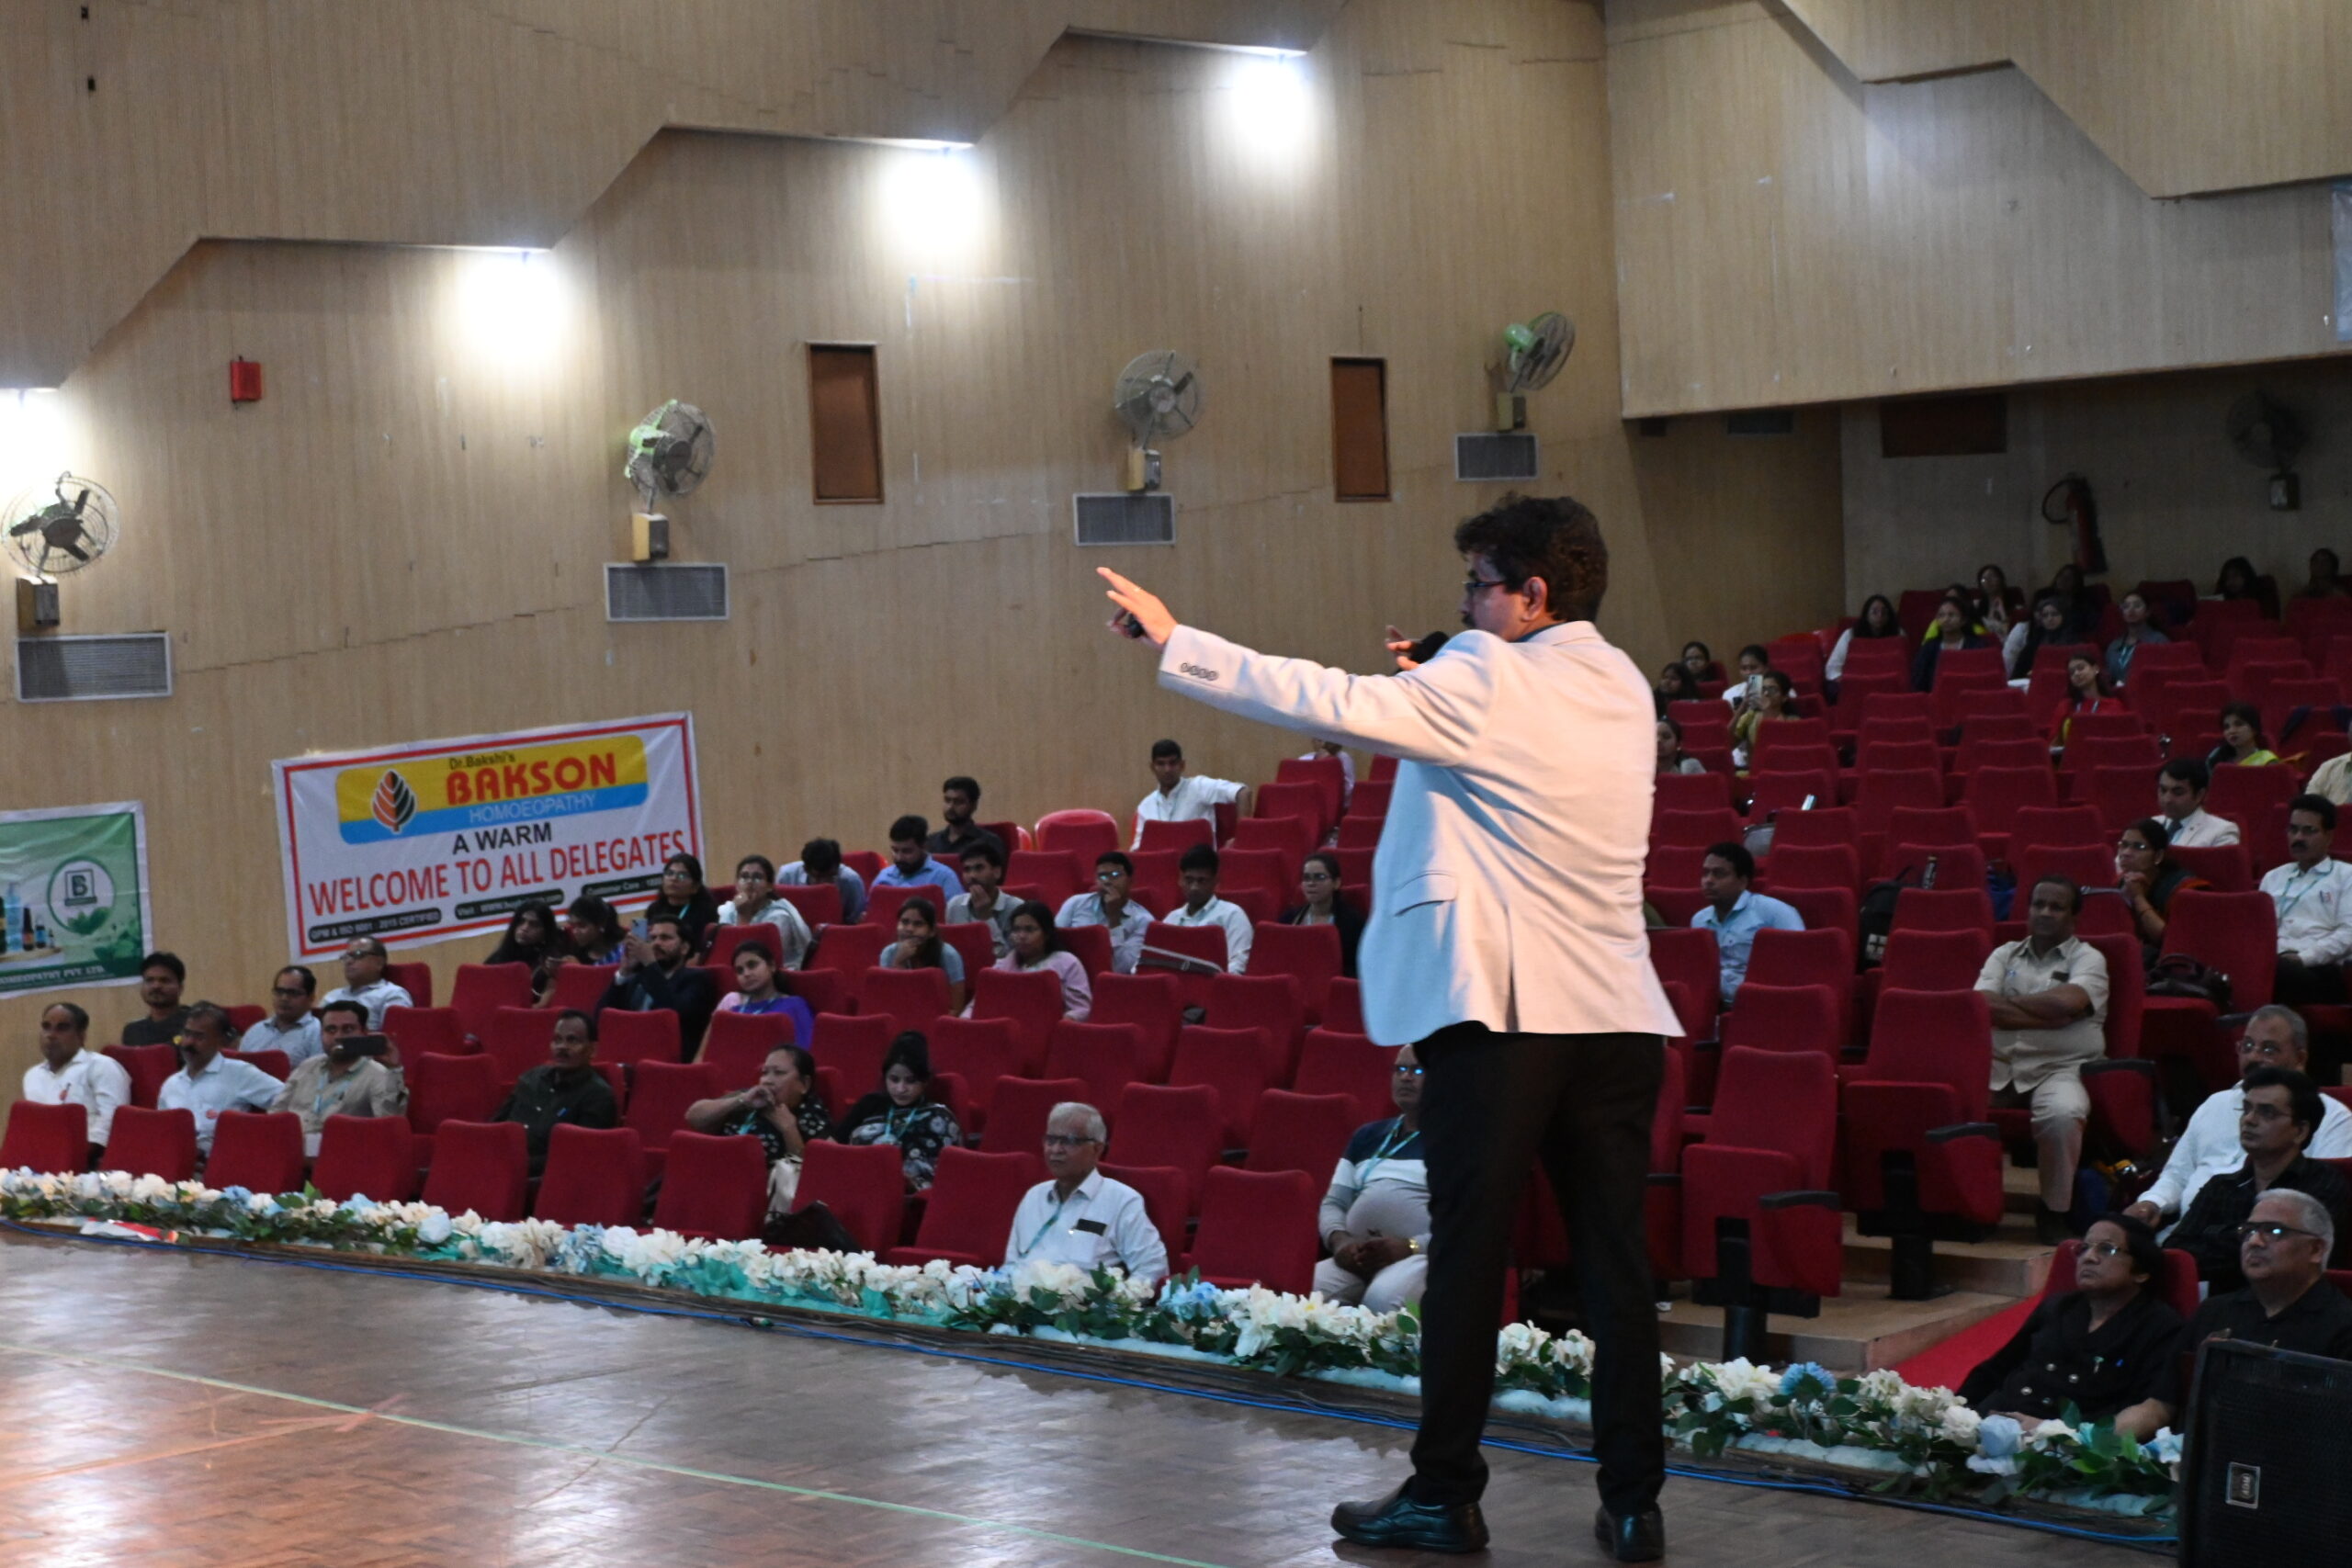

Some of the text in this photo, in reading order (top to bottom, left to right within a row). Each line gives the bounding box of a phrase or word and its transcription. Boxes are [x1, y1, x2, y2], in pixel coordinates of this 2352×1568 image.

[447, 752, 617, 807] BAKSON
[469, 793, 596, 824] HOMOEOPATHY
[452, 822, 552, 855] A WARM
[309, 829, 686, 917] WELCOME TO ALL DELEGATES
